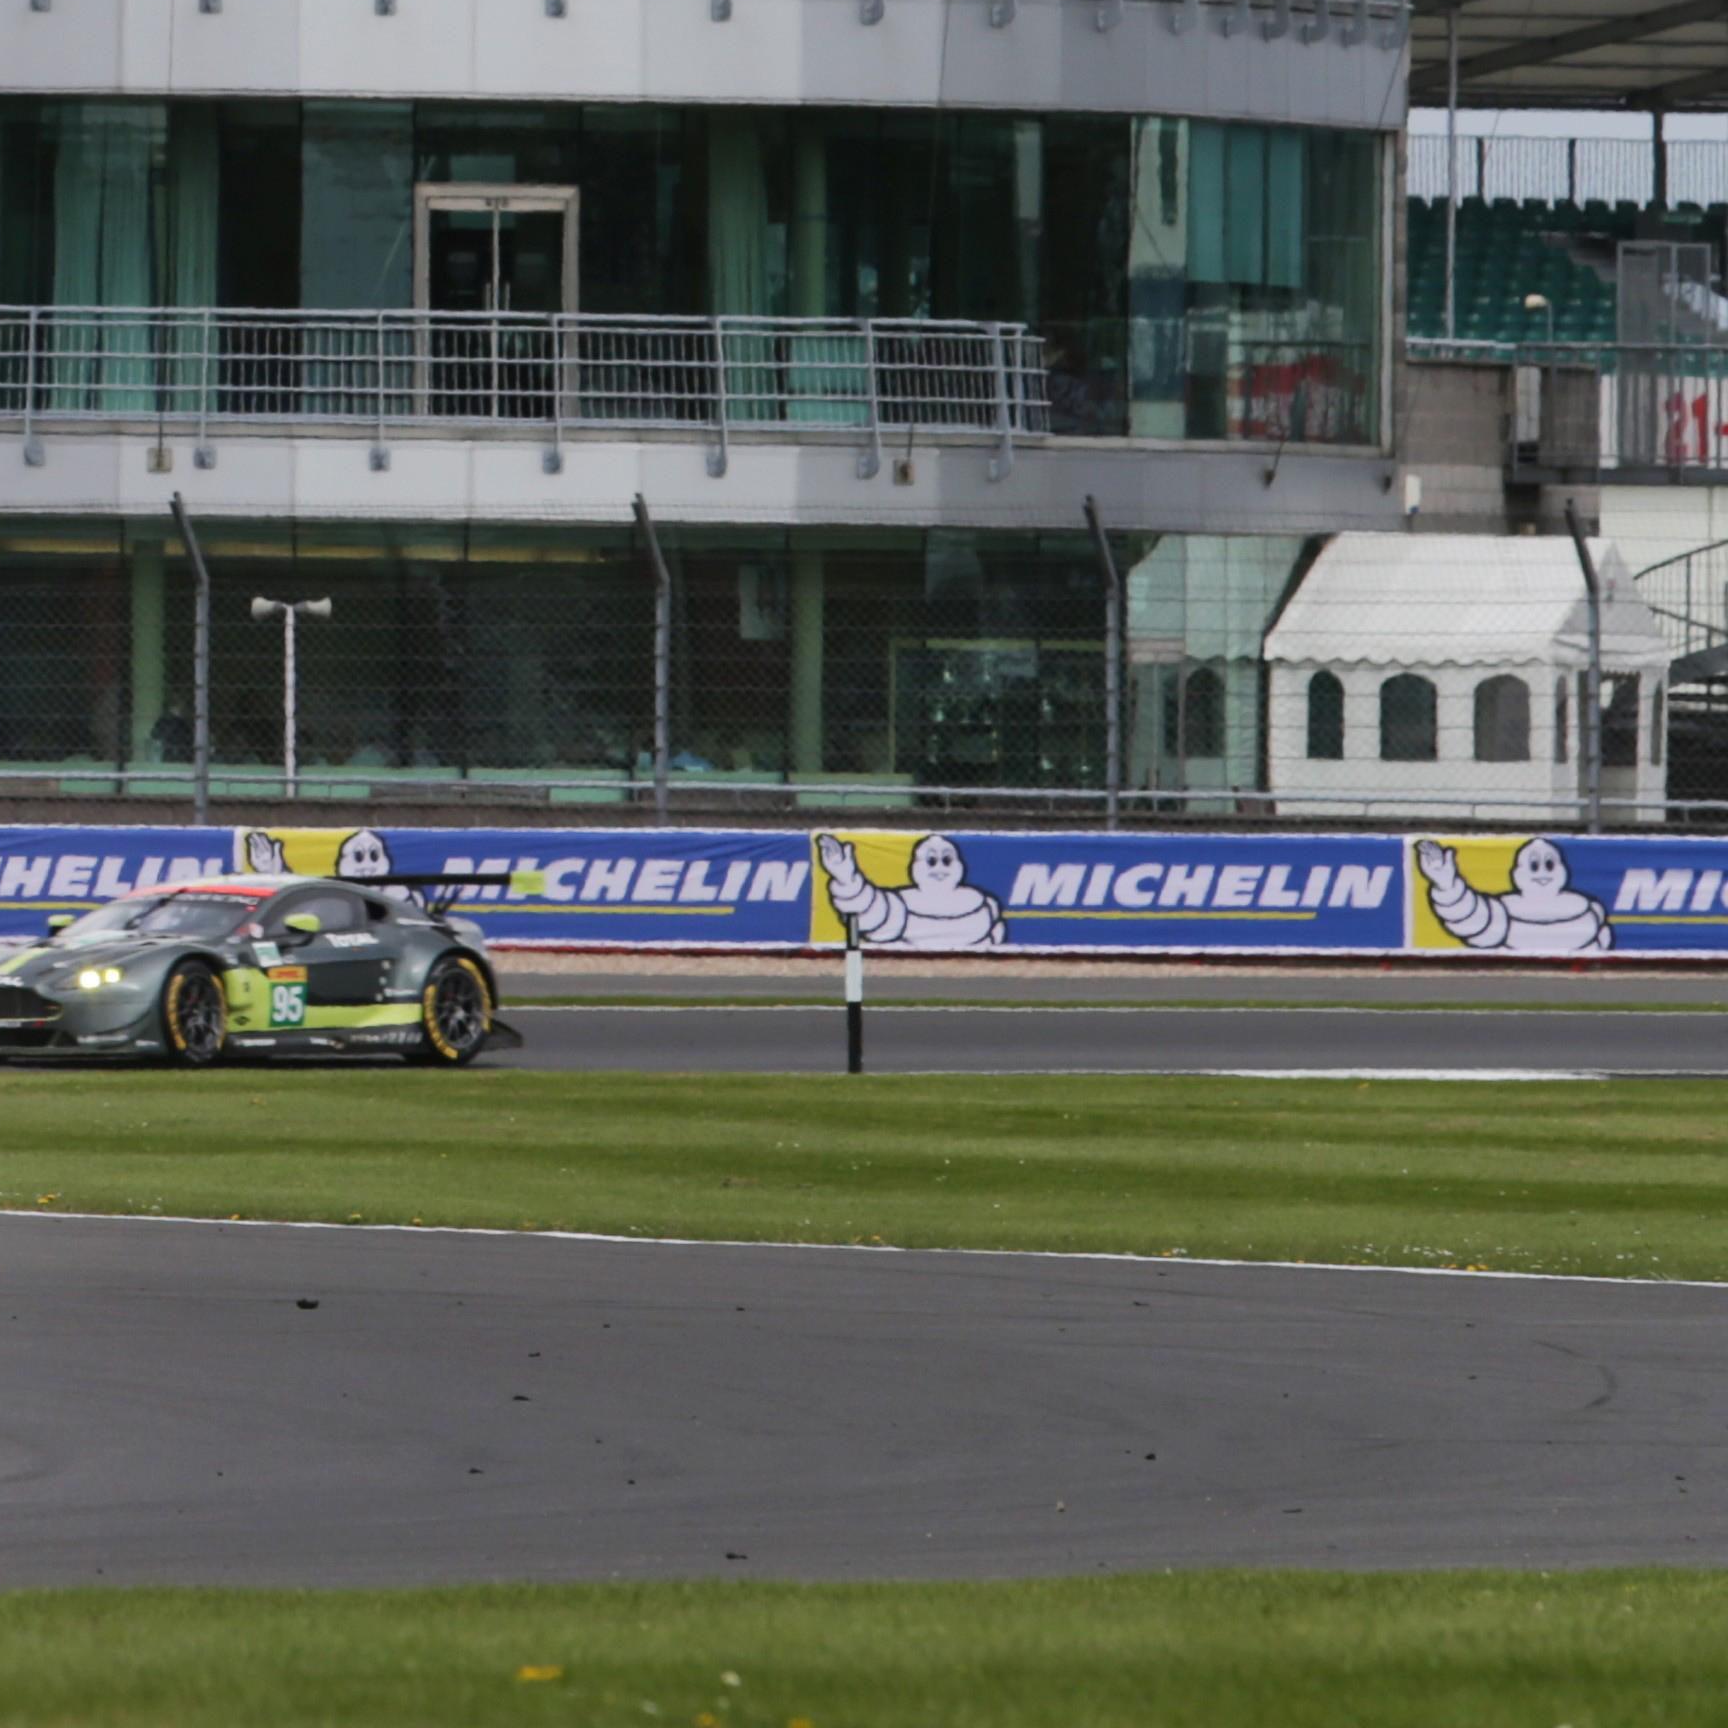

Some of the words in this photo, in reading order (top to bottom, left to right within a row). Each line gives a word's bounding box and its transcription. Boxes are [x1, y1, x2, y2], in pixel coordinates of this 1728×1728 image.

[1008, 863, 1394, 909] MICHELIN
[1613, 869, 1728, 912] MI
[272, 985, 304, 1022] 95
